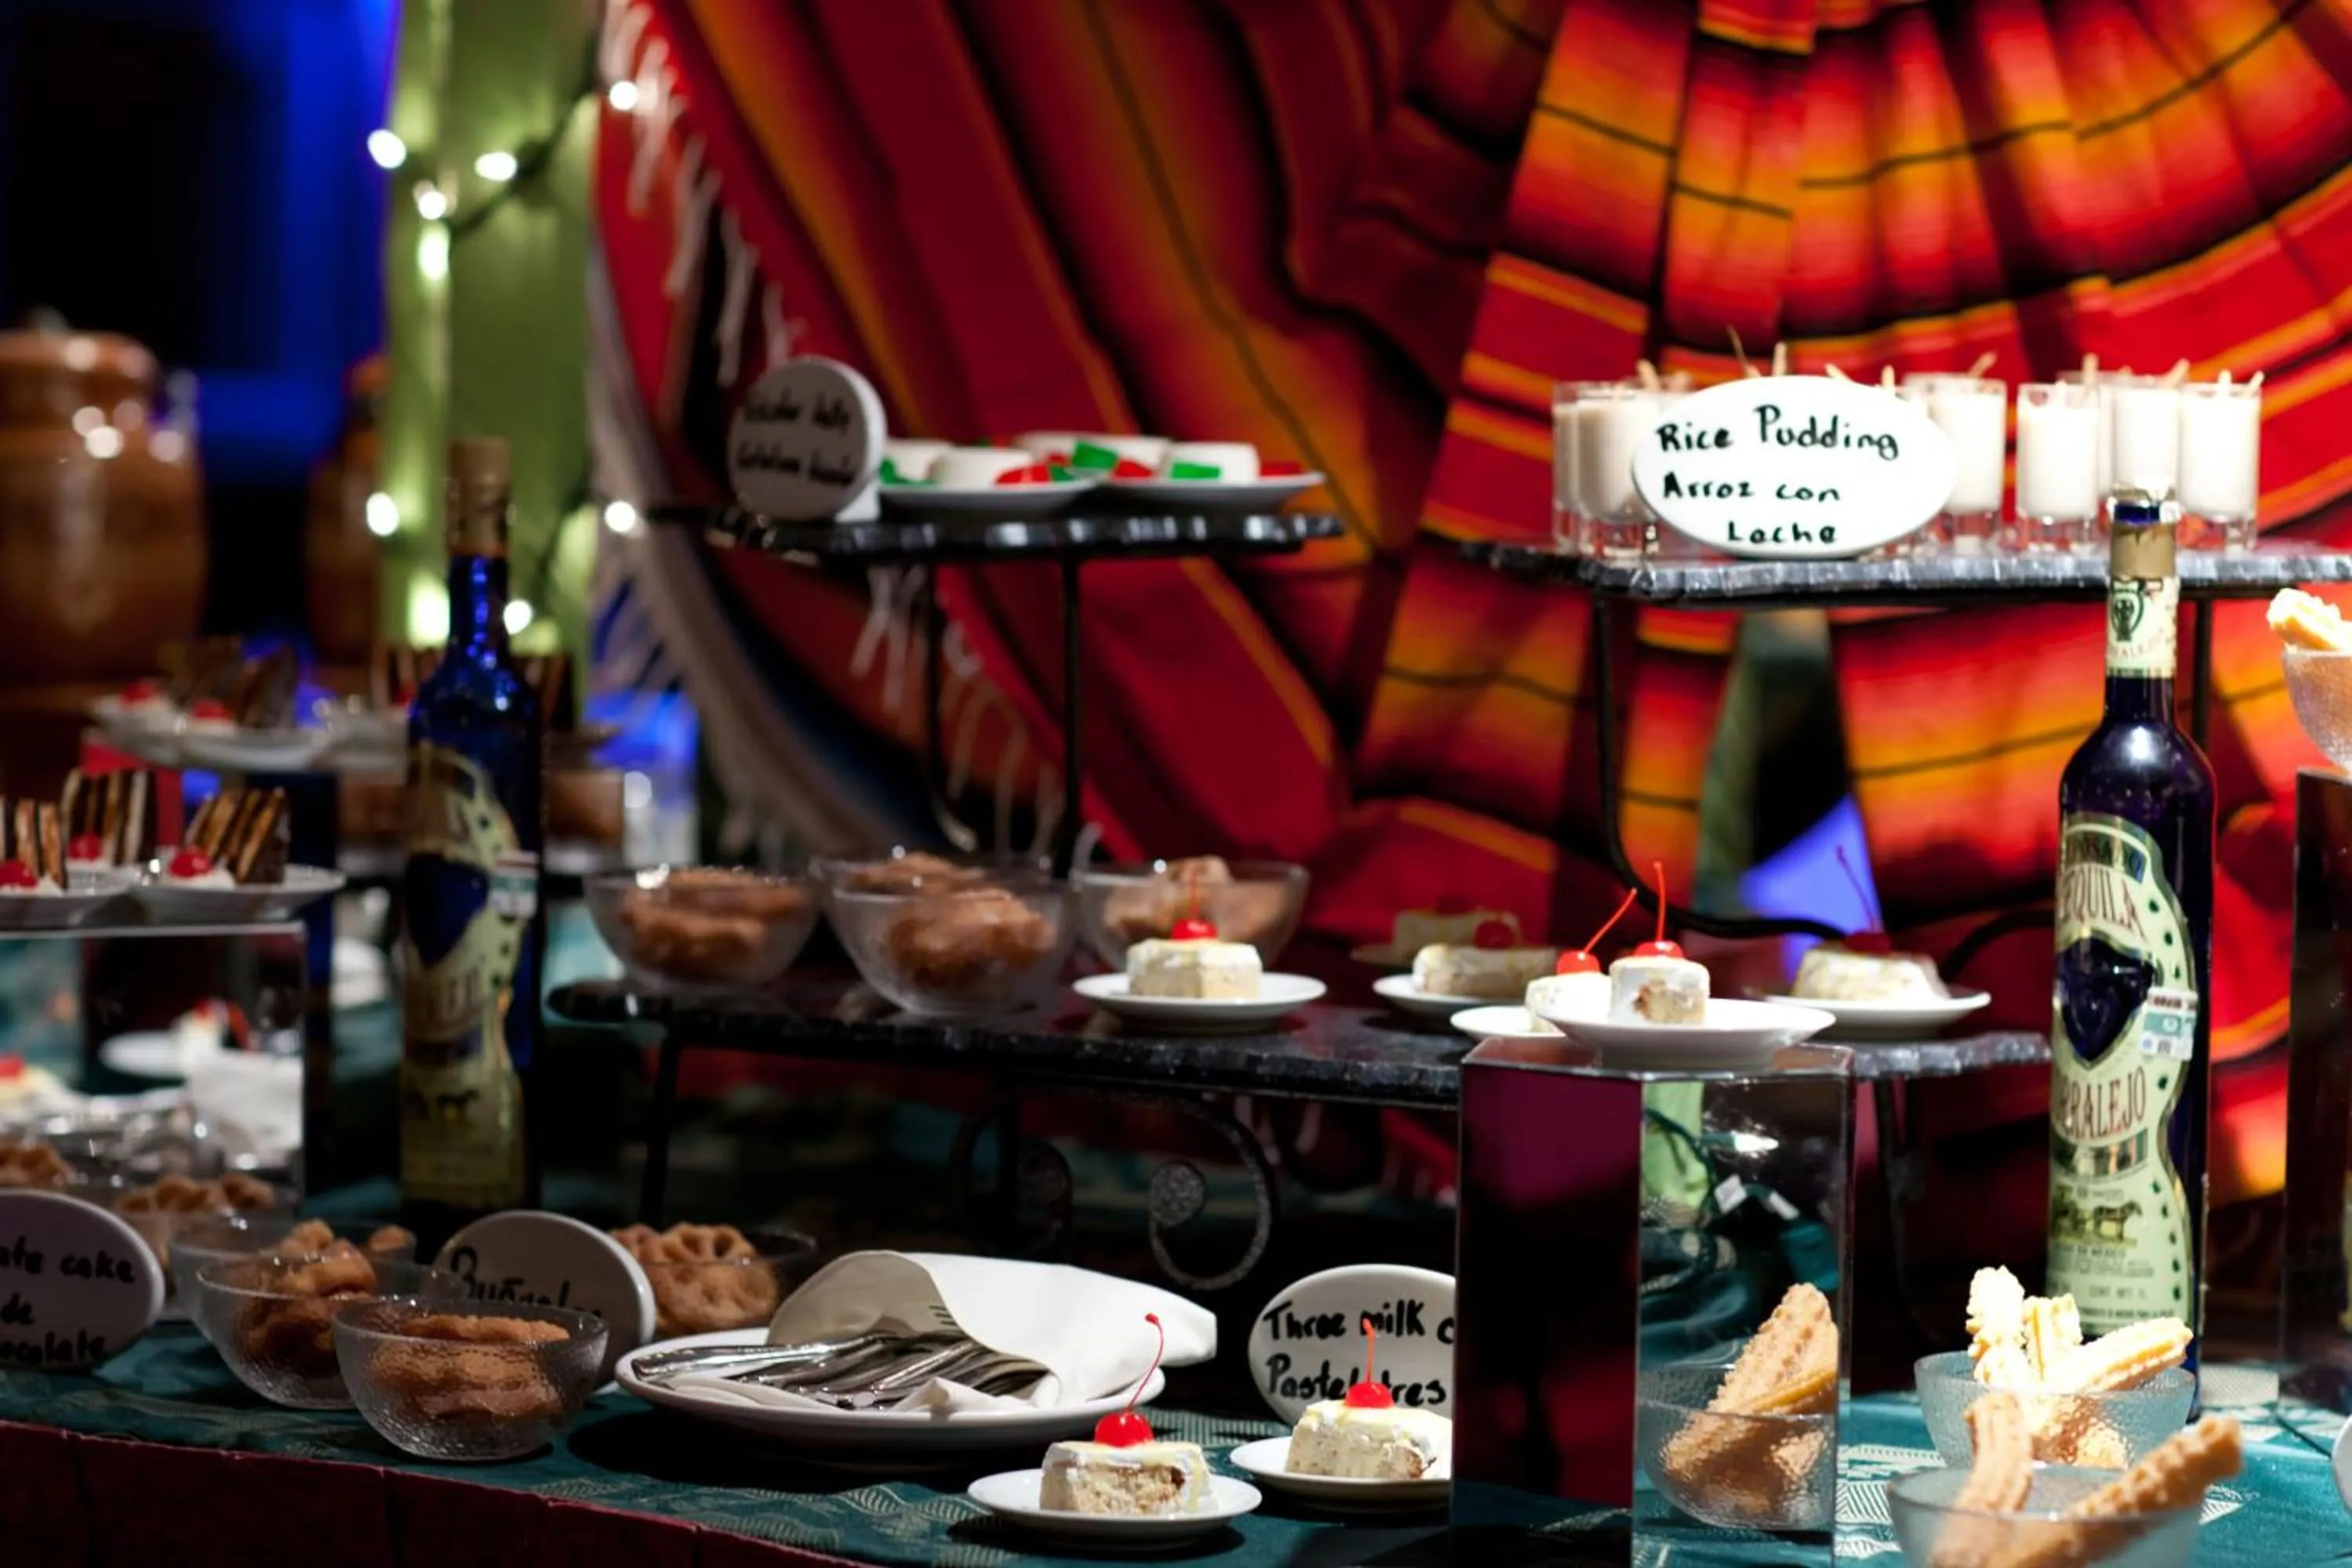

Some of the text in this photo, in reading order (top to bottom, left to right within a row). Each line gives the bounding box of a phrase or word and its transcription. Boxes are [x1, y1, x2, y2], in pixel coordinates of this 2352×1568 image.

[1656, 404, 1899, 460] Rice Pudding
[1663, 471, 1840, 502] Arroz con
[60, 1250, 136, 1283] cake
[0, 1292, 35, 1325] de
[1262, 1300, 1346, 1341] Three
